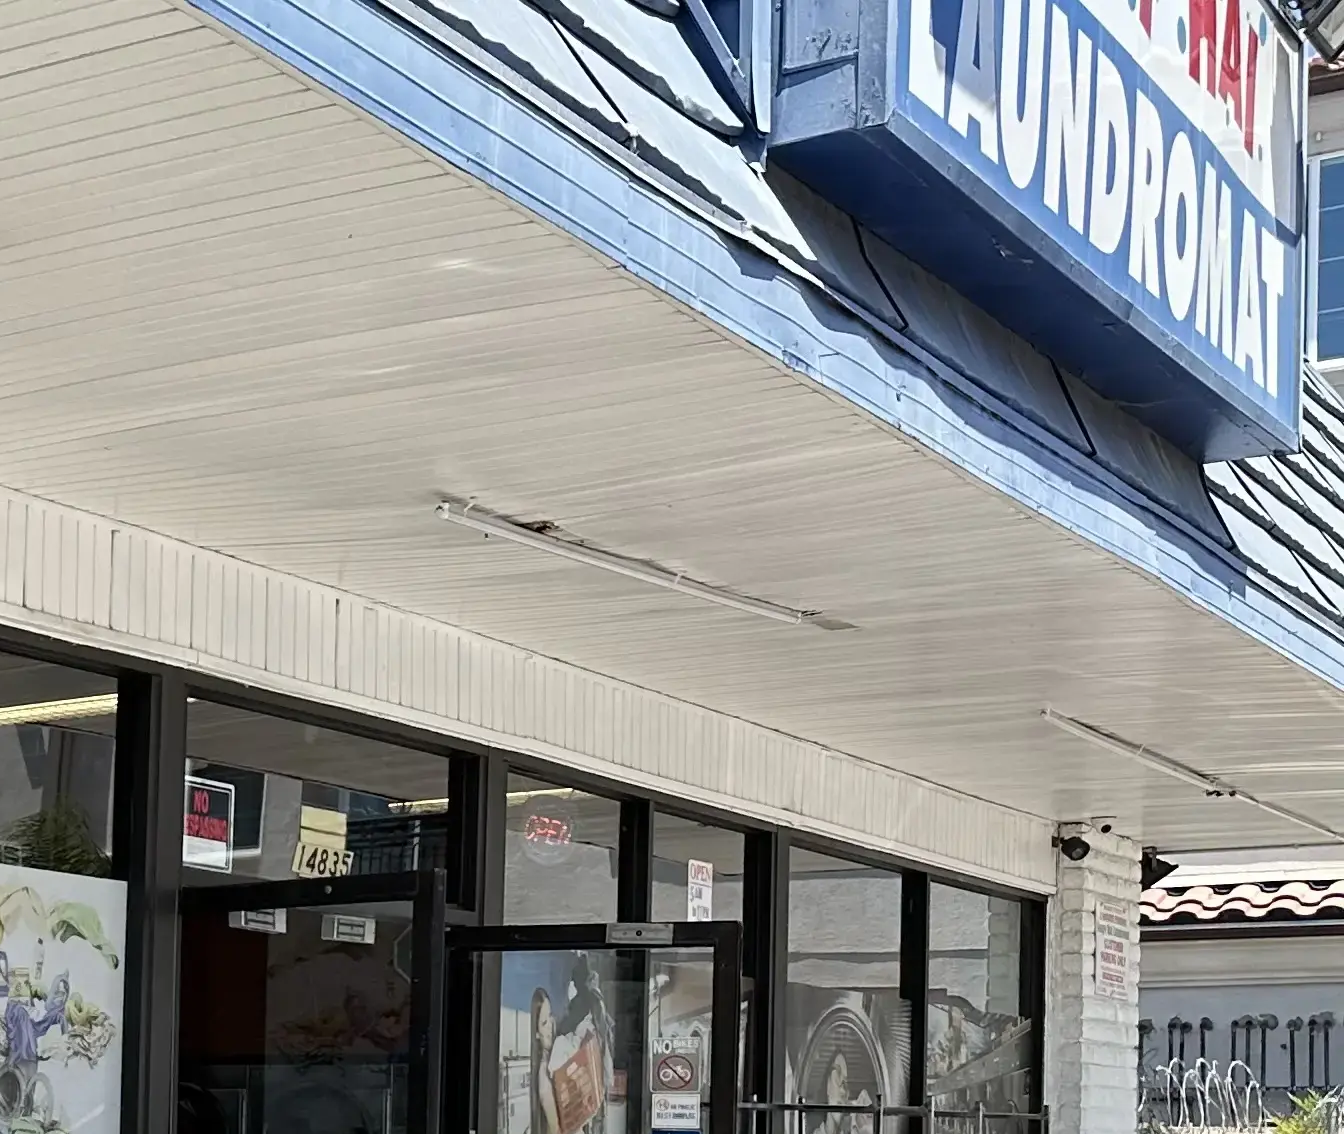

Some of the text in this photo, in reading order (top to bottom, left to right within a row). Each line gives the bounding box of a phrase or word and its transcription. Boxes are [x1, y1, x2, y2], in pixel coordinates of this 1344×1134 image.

[193, 789, 210, 814] NO
[298, 844, 352, 877] 14835
[690, 862, 712, 883] OPEN
[653, 1039, 672, 1055] NO
